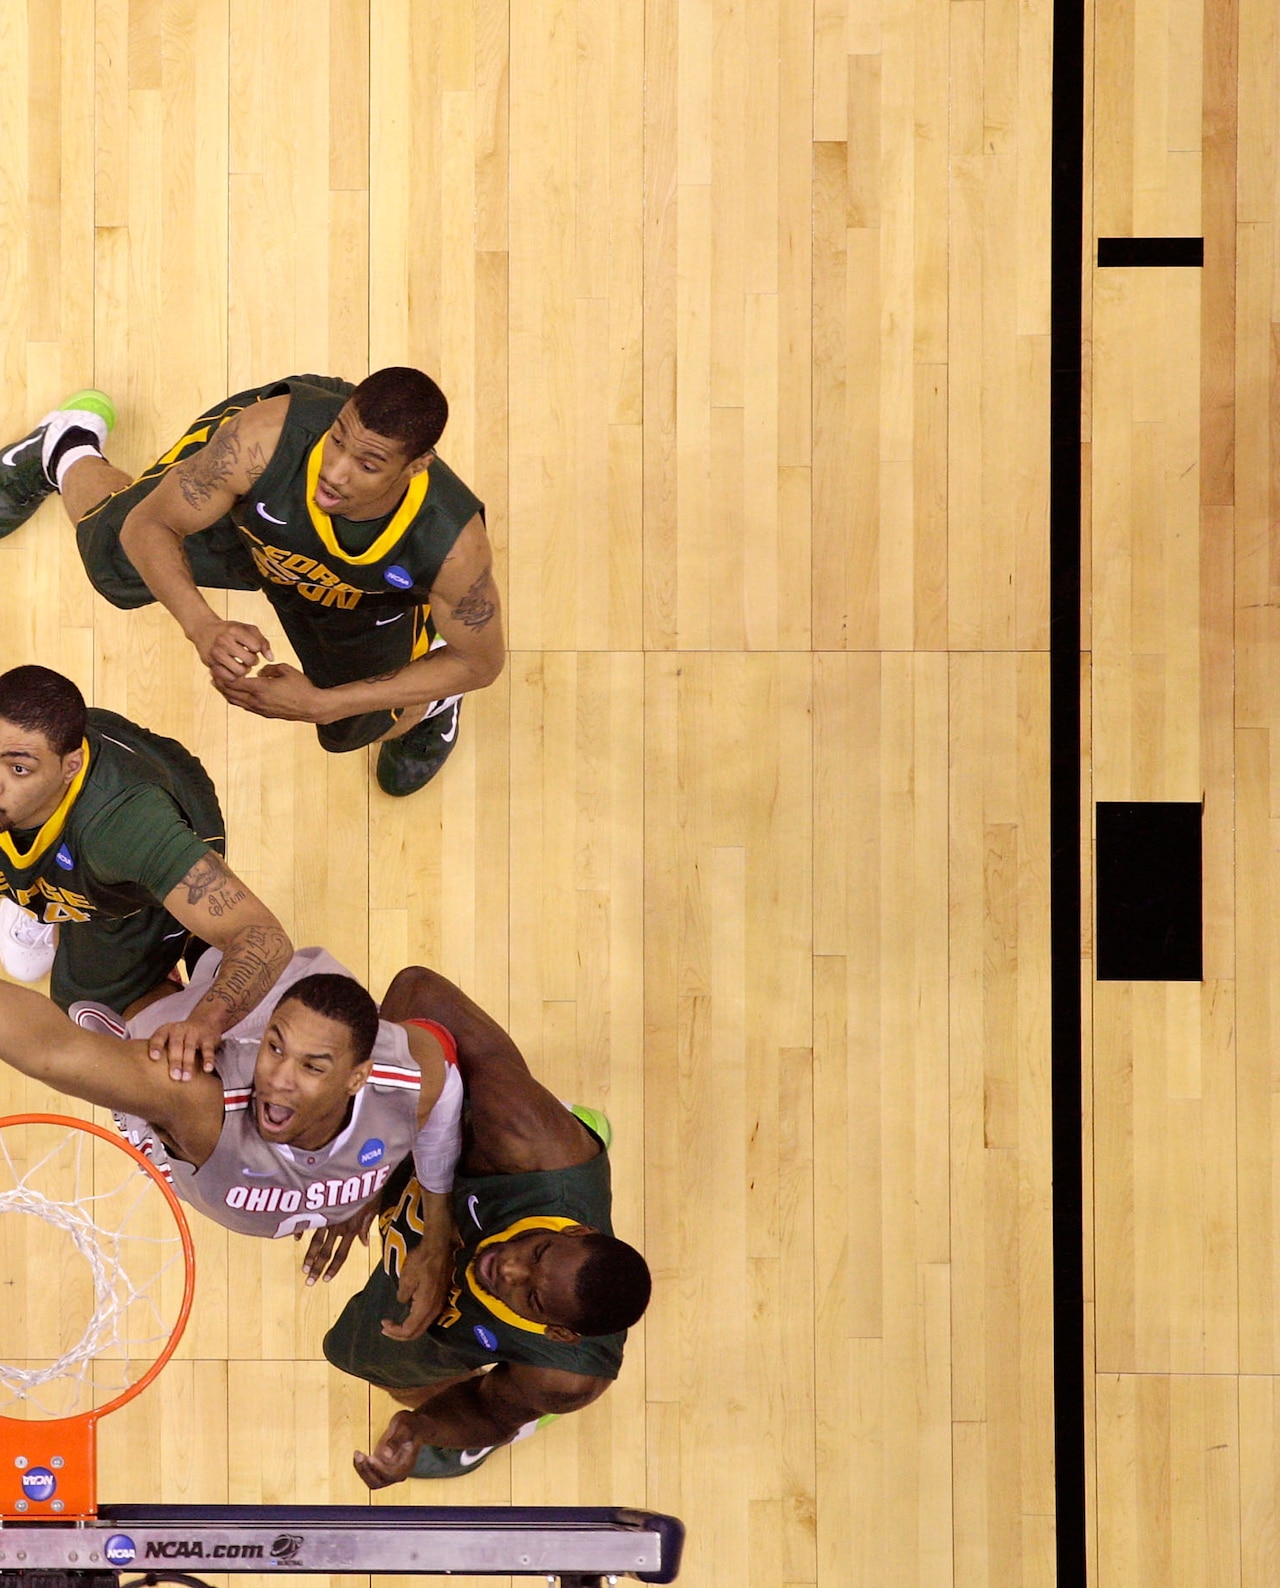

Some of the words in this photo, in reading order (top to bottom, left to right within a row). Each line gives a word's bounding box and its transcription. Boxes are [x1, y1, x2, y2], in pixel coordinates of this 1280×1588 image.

[361, 1148, 383, 1163] NCAA
[225, 1186, 302, 1213] OHIO
[305, 1164, 391, 1211] STATE
[22, 1474, 53, 1486] NCAA
[107, 1548, 136, 1559] NCAA
[145, 1541, 264, 1559] NCAA.com
